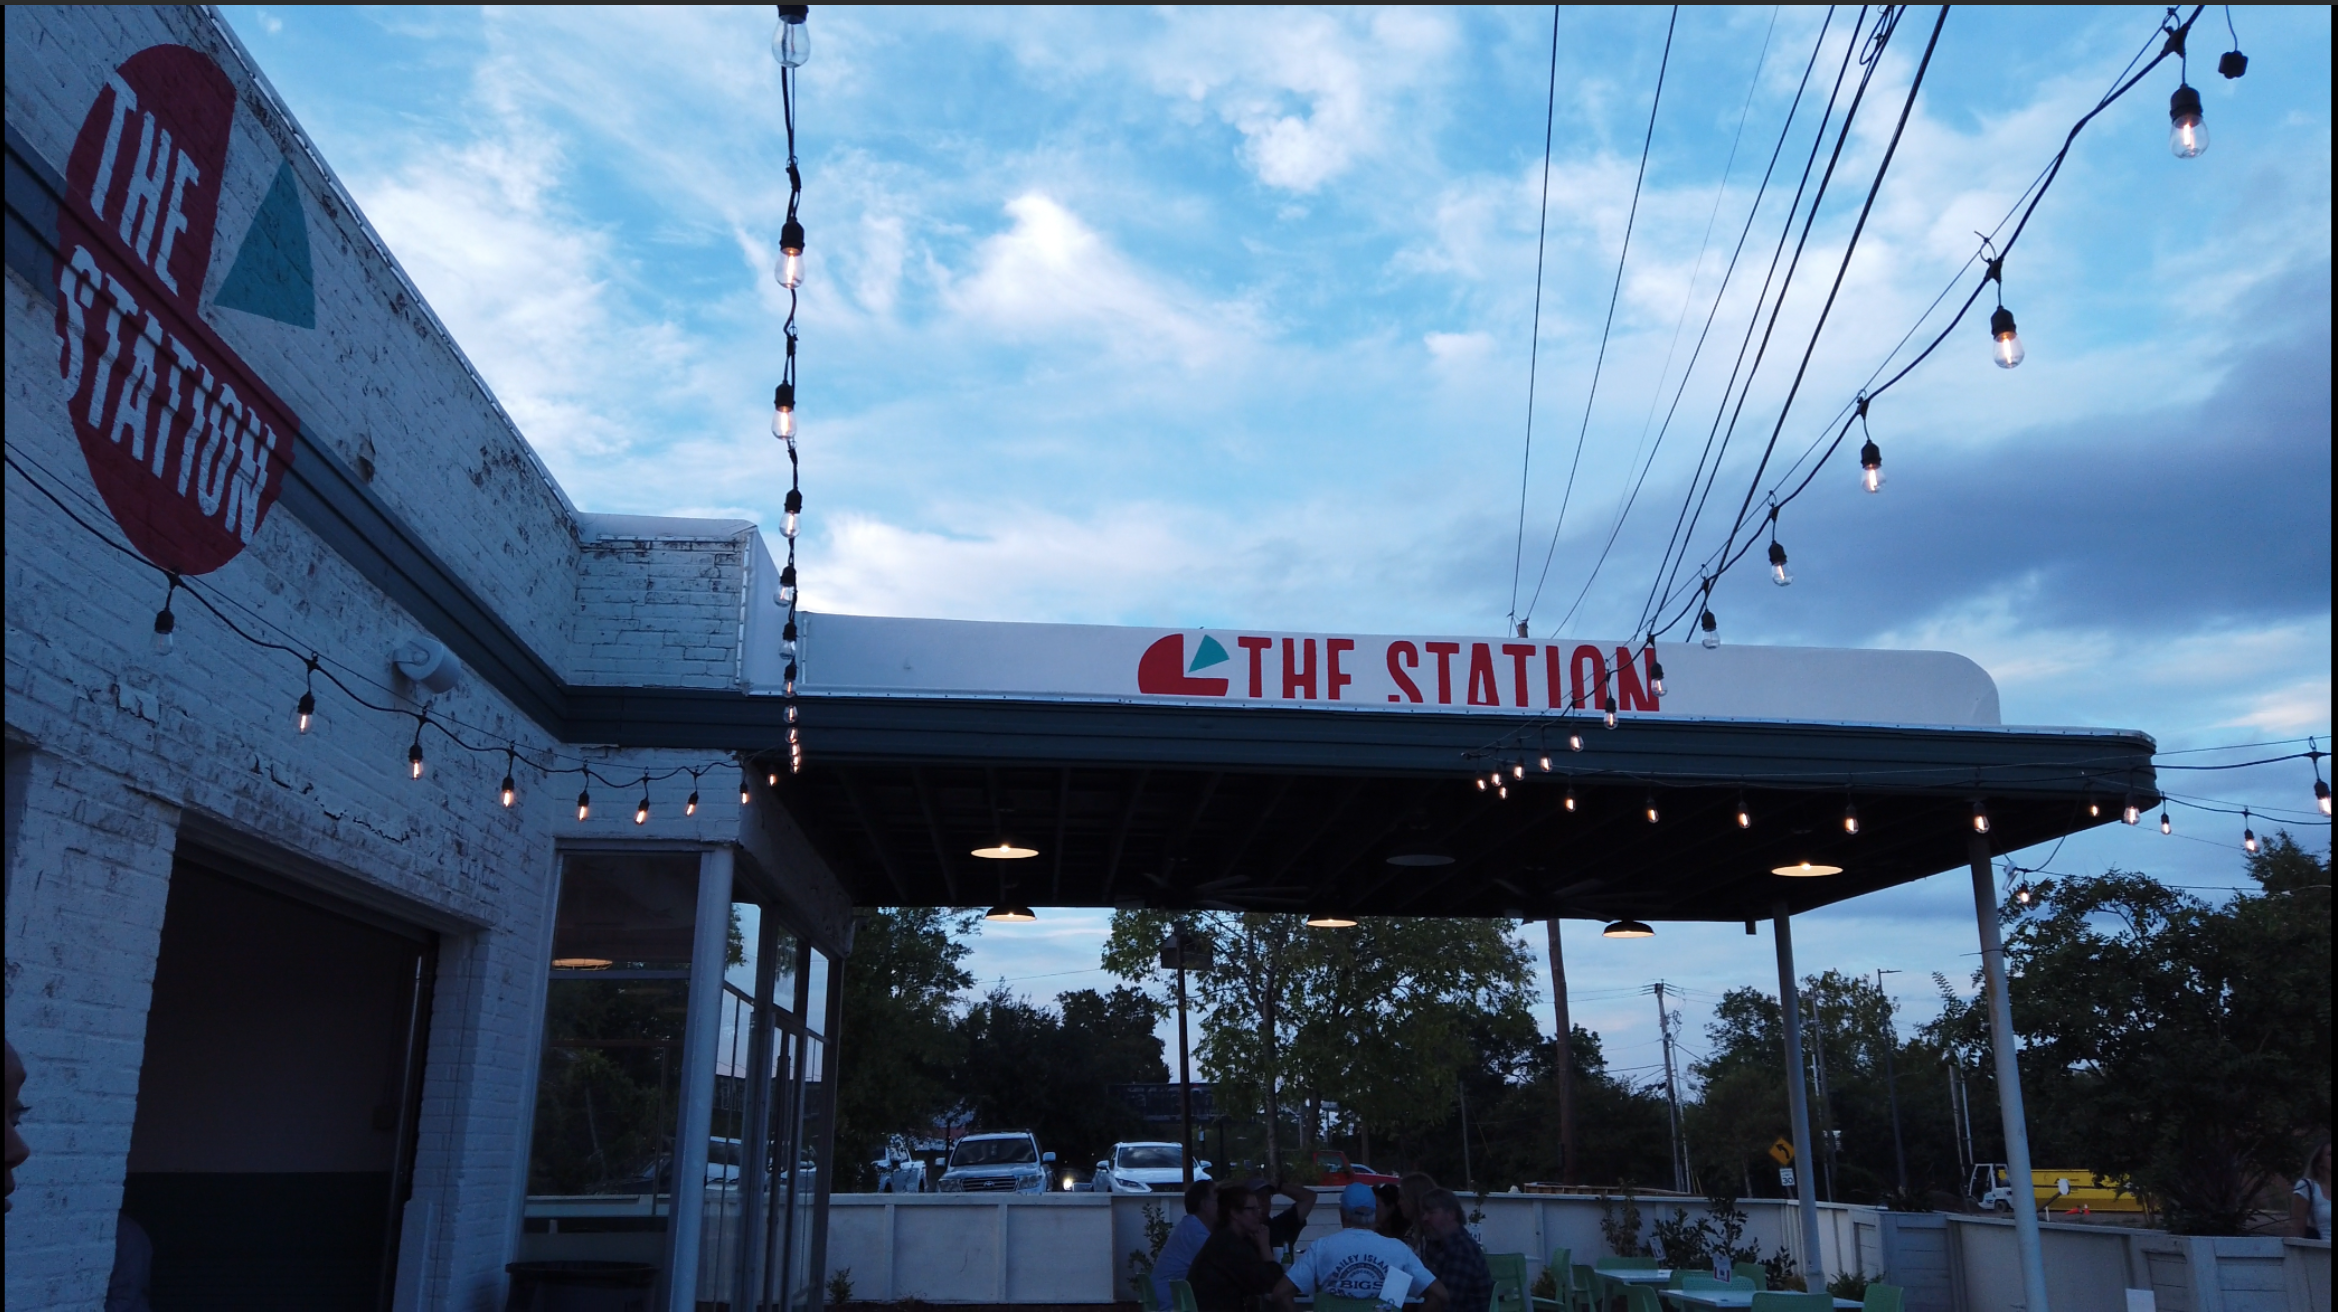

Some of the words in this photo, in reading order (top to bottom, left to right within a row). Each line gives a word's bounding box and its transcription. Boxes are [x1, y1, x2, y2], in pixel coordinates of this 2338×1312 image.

[91, 70, 199, 298] THE
[56, 244, 277, 547] STATION
[1237, 636, 1355, 701] THE
[1386, 640, 1661, 712] STATION
[1332, 1253, 1359, 1278] BAILEY
[1363, 1253, 1389, 1274] ISLAN
